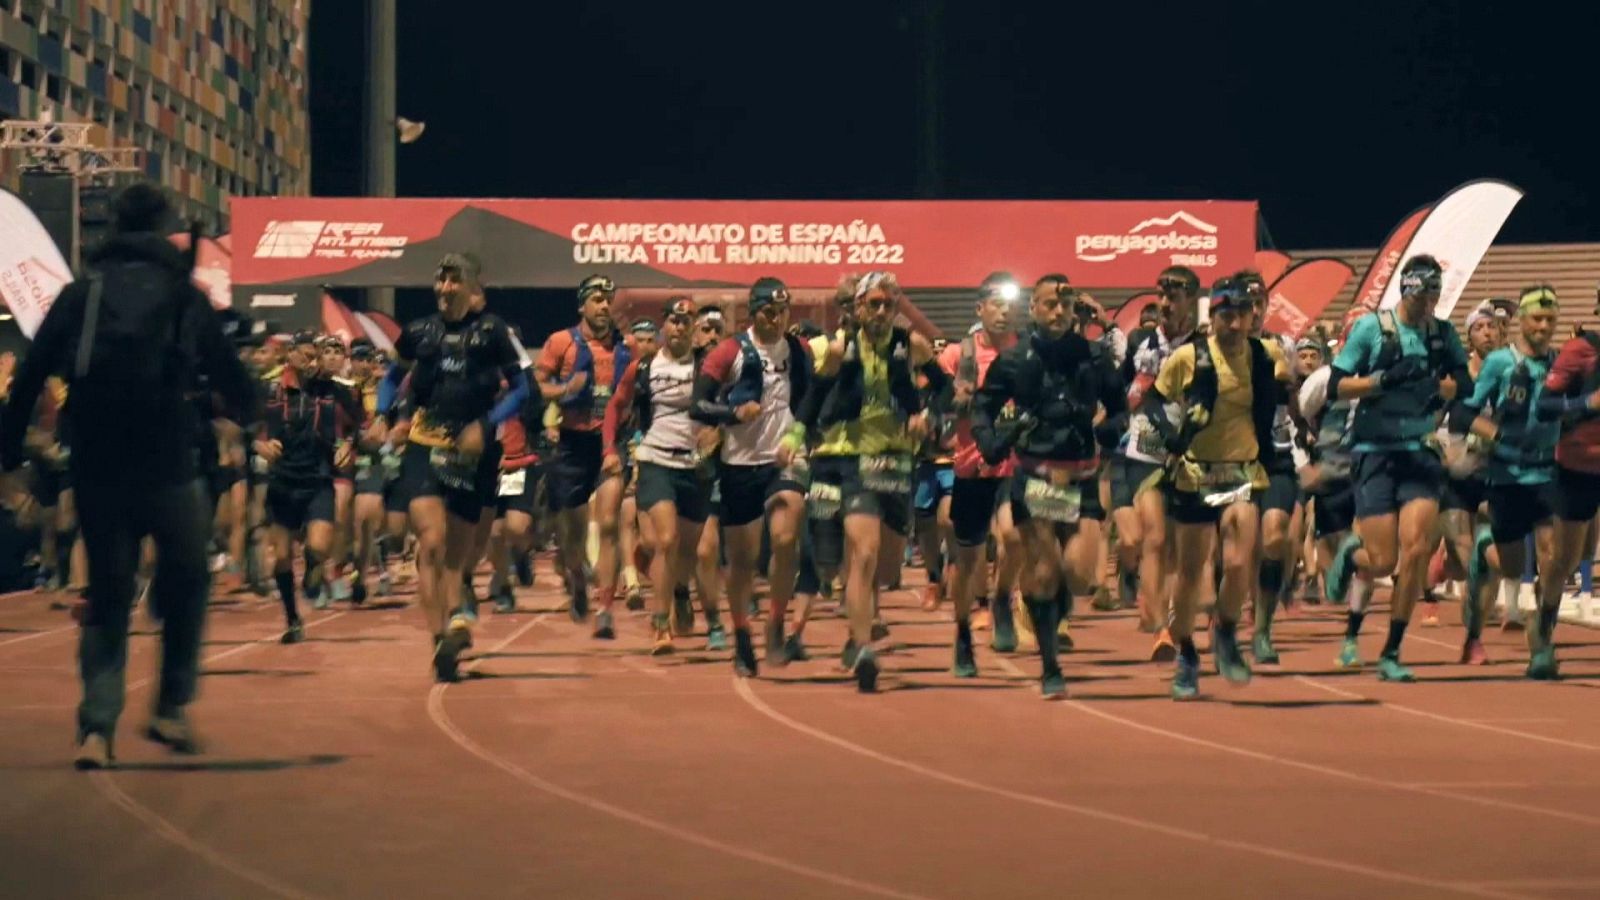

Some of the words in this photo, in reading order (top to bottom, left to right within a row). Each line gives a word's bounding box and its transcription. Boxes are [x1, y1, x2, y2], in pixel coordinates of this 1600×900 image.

[571, 223, 745, 243] CAMPEONATO
[749, 223, 784, 243] DE
[789, 219, 886, 243] ESPAÑA
[1075, 231, 1218, 254] penyagolosa
[572, 245, 649, 264] ULTRA
[655, 245, 720, 264] TRAIL
[726, 245, 841, 264] RUNNING
[847, 244, 905, 264] 2022
[1170, 254, 1218, 267] TRAILS
